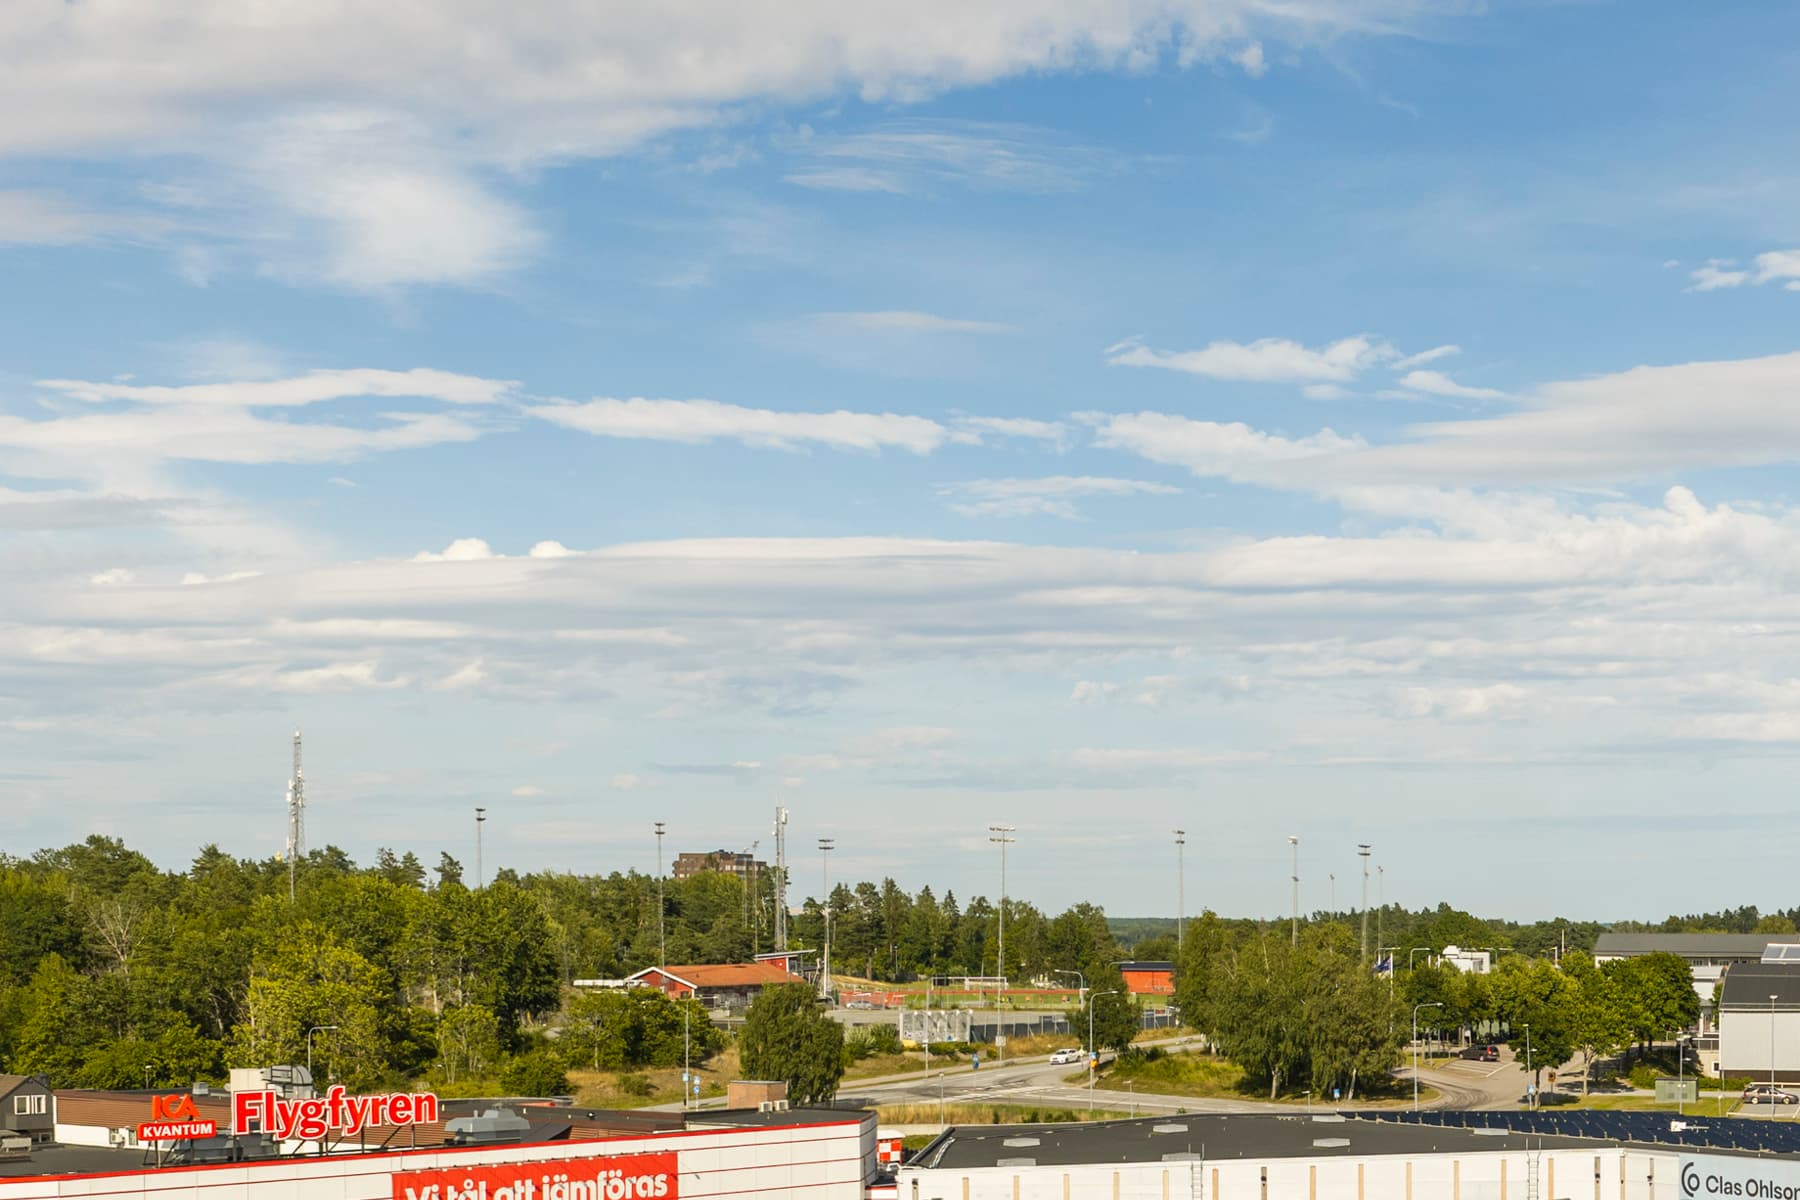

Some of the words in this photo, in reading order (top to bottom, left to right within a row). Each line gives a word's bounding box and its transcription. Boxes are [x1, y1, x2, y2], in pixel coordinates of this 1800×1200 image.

[152, 1093, 200, 1120] ICA
[232, 1085, 438, 1141] Flygfyren
[142, 1123, 213, 1137] KVANTUM
[1706, 1175, 1743, 1196] Clas
